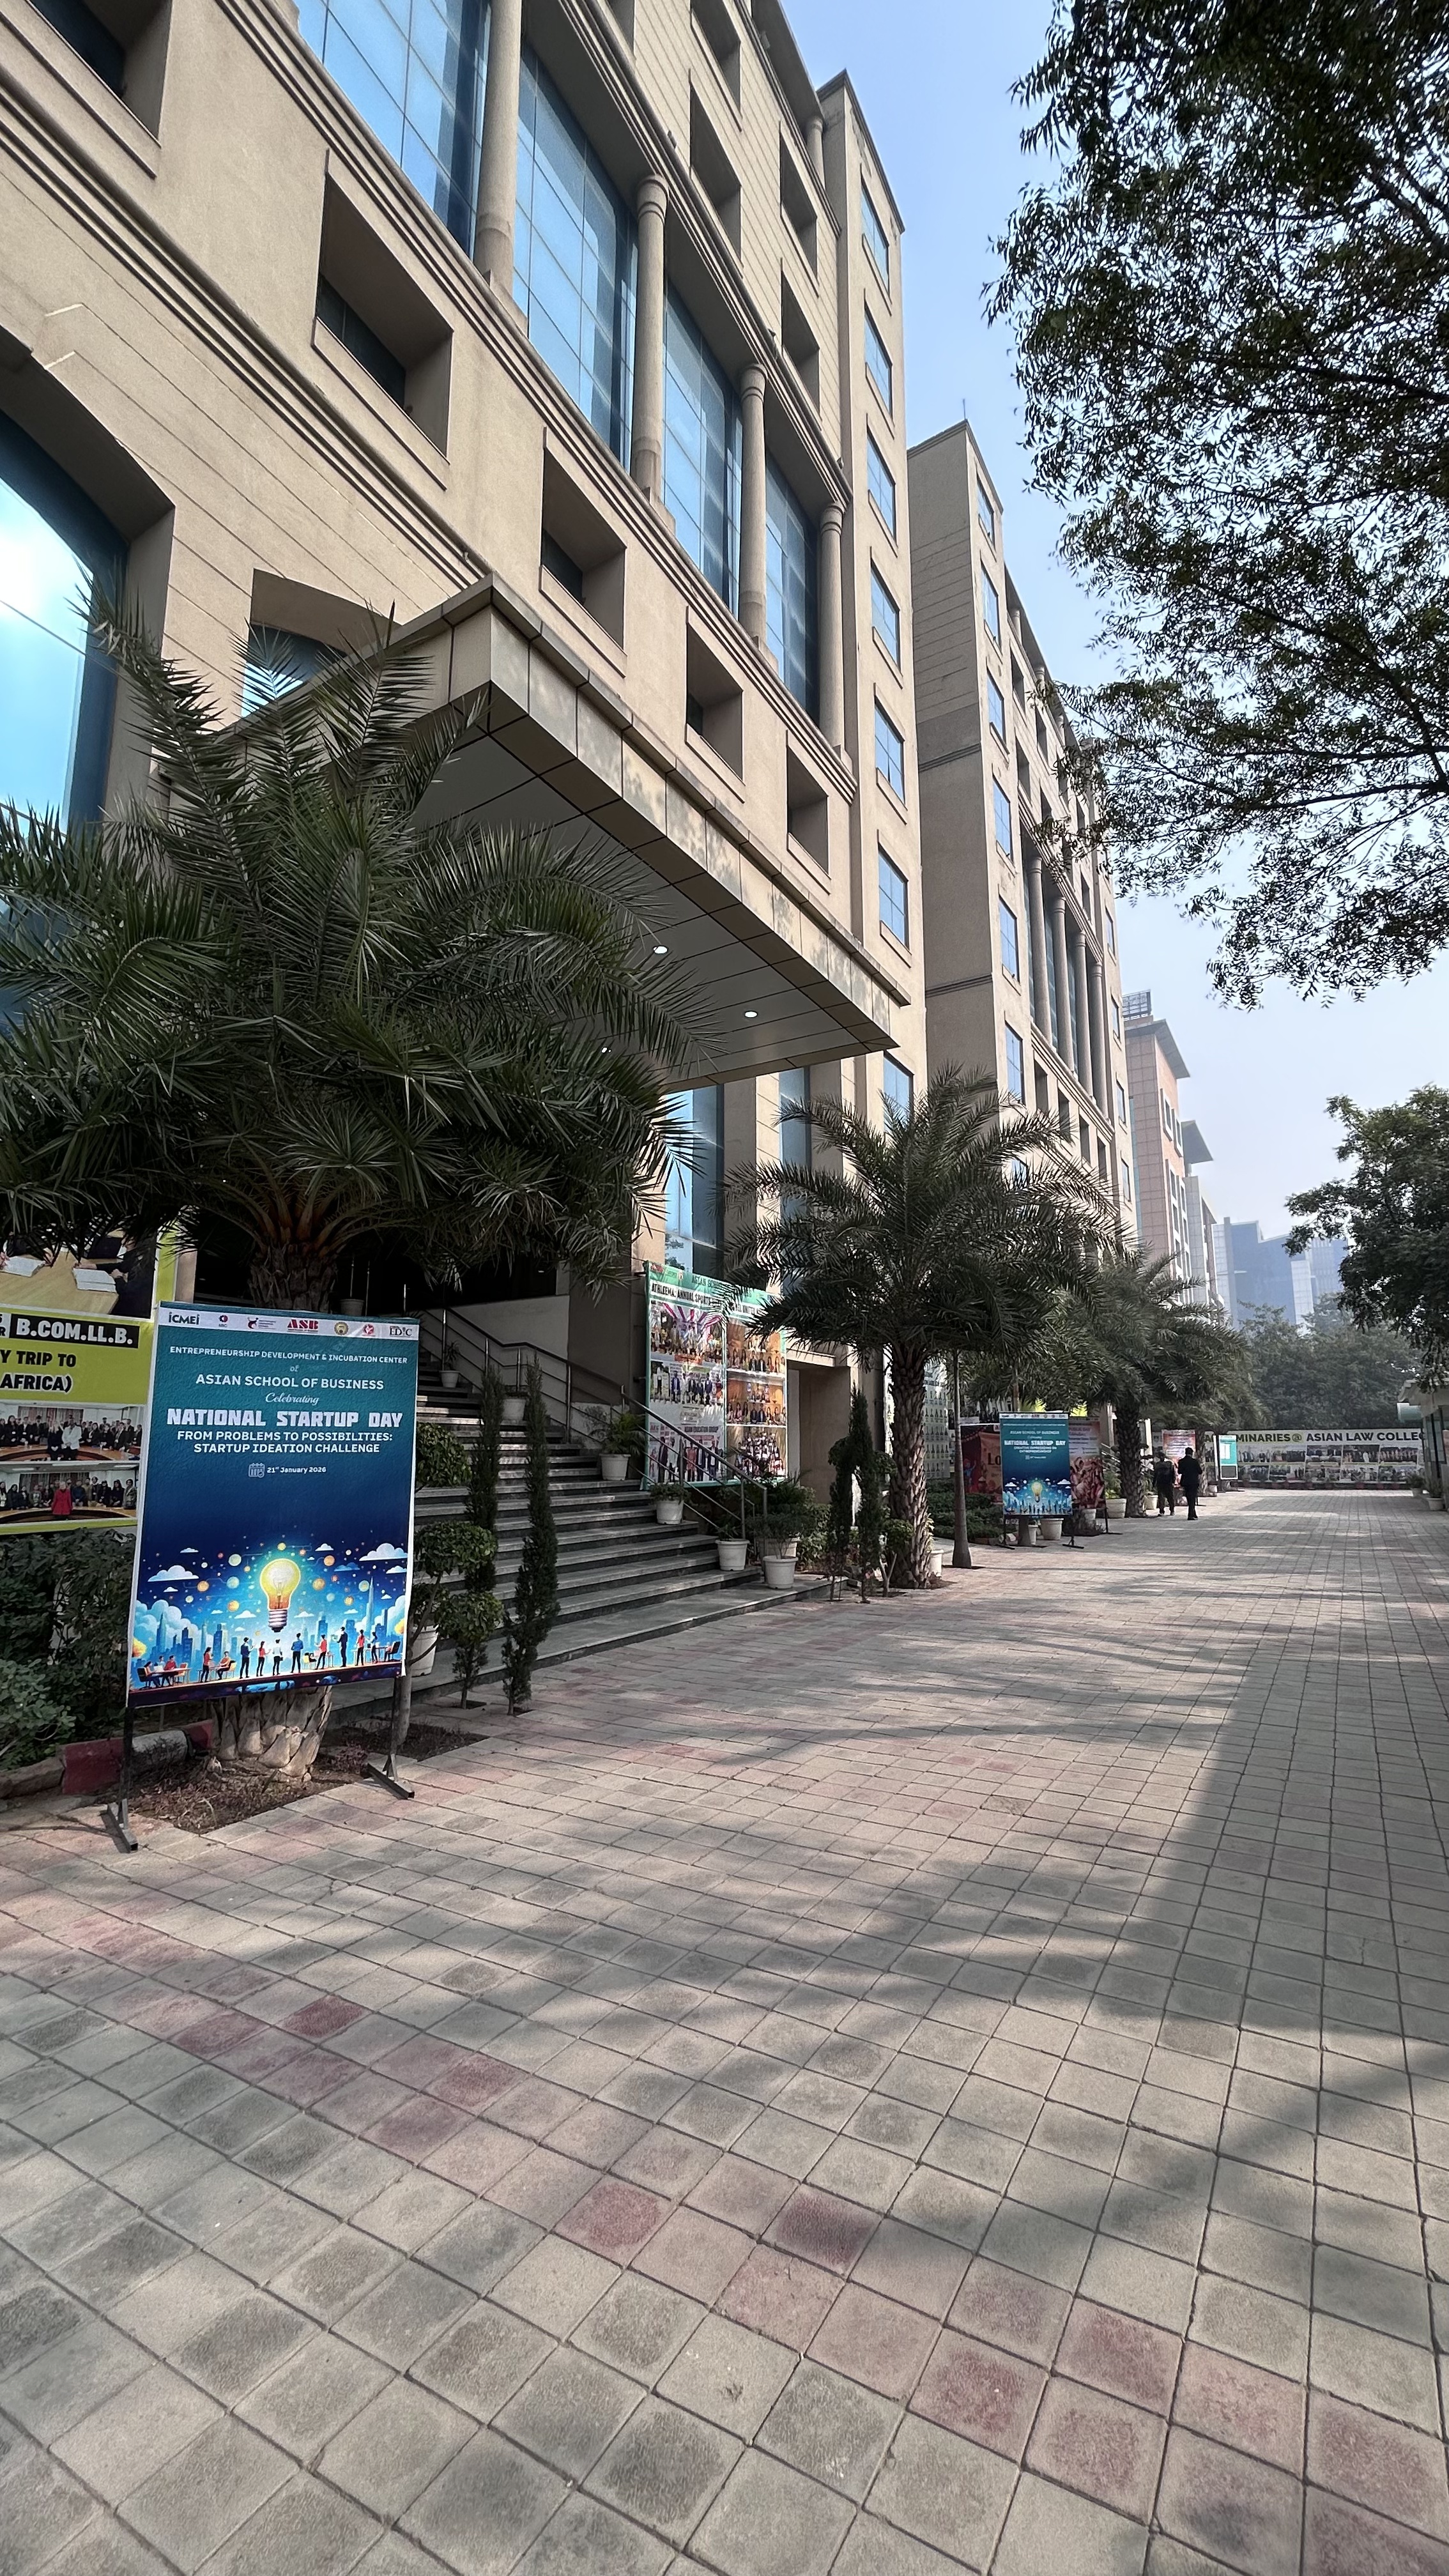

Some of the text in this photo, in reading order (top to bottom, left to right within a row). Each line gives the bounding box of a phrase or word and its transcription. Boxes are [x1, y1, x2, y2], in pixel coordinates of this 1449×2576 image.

[677, 1289, 694, 1302] ANNUAL
[16, 1318, 133, 1345] B.COM.LL.B.
[288, 1319, 319, 1330] ASB
[16, 1351, 53, 1365] TRIP
[57, 1354, 77, 1367] TO
[169, 1346, 260, 1357] ENTREPRENEURSHIP
[261, 1351, 321, 1361] DEVELOPMENT
[328, 1354, 378, 1363] INCUBATION
[0, 1374, 72, 1393] AFRICA)
[195, 1374, 384, 1390] ASIAN SCHOOL OF BUSINESS
[265, 1392, 319, 1406] Celebrating
[167, 1408, 403, 1428] NATIONAL STARTUP DAY
[177, 1430, 393, 1441] FROM PROBLEMS TO POSSIBILITIES:
[1236, 1433, 1291, 1442] MINARIES
[1292, 1434, 1302, 1442] @
[1306, 1433, 1342, 1442] ASIAN
[1346, 1432, 1374, 1441] LAW
[194, 1443, 380, 1453] STARTUP IDEATION CHALLENGE
